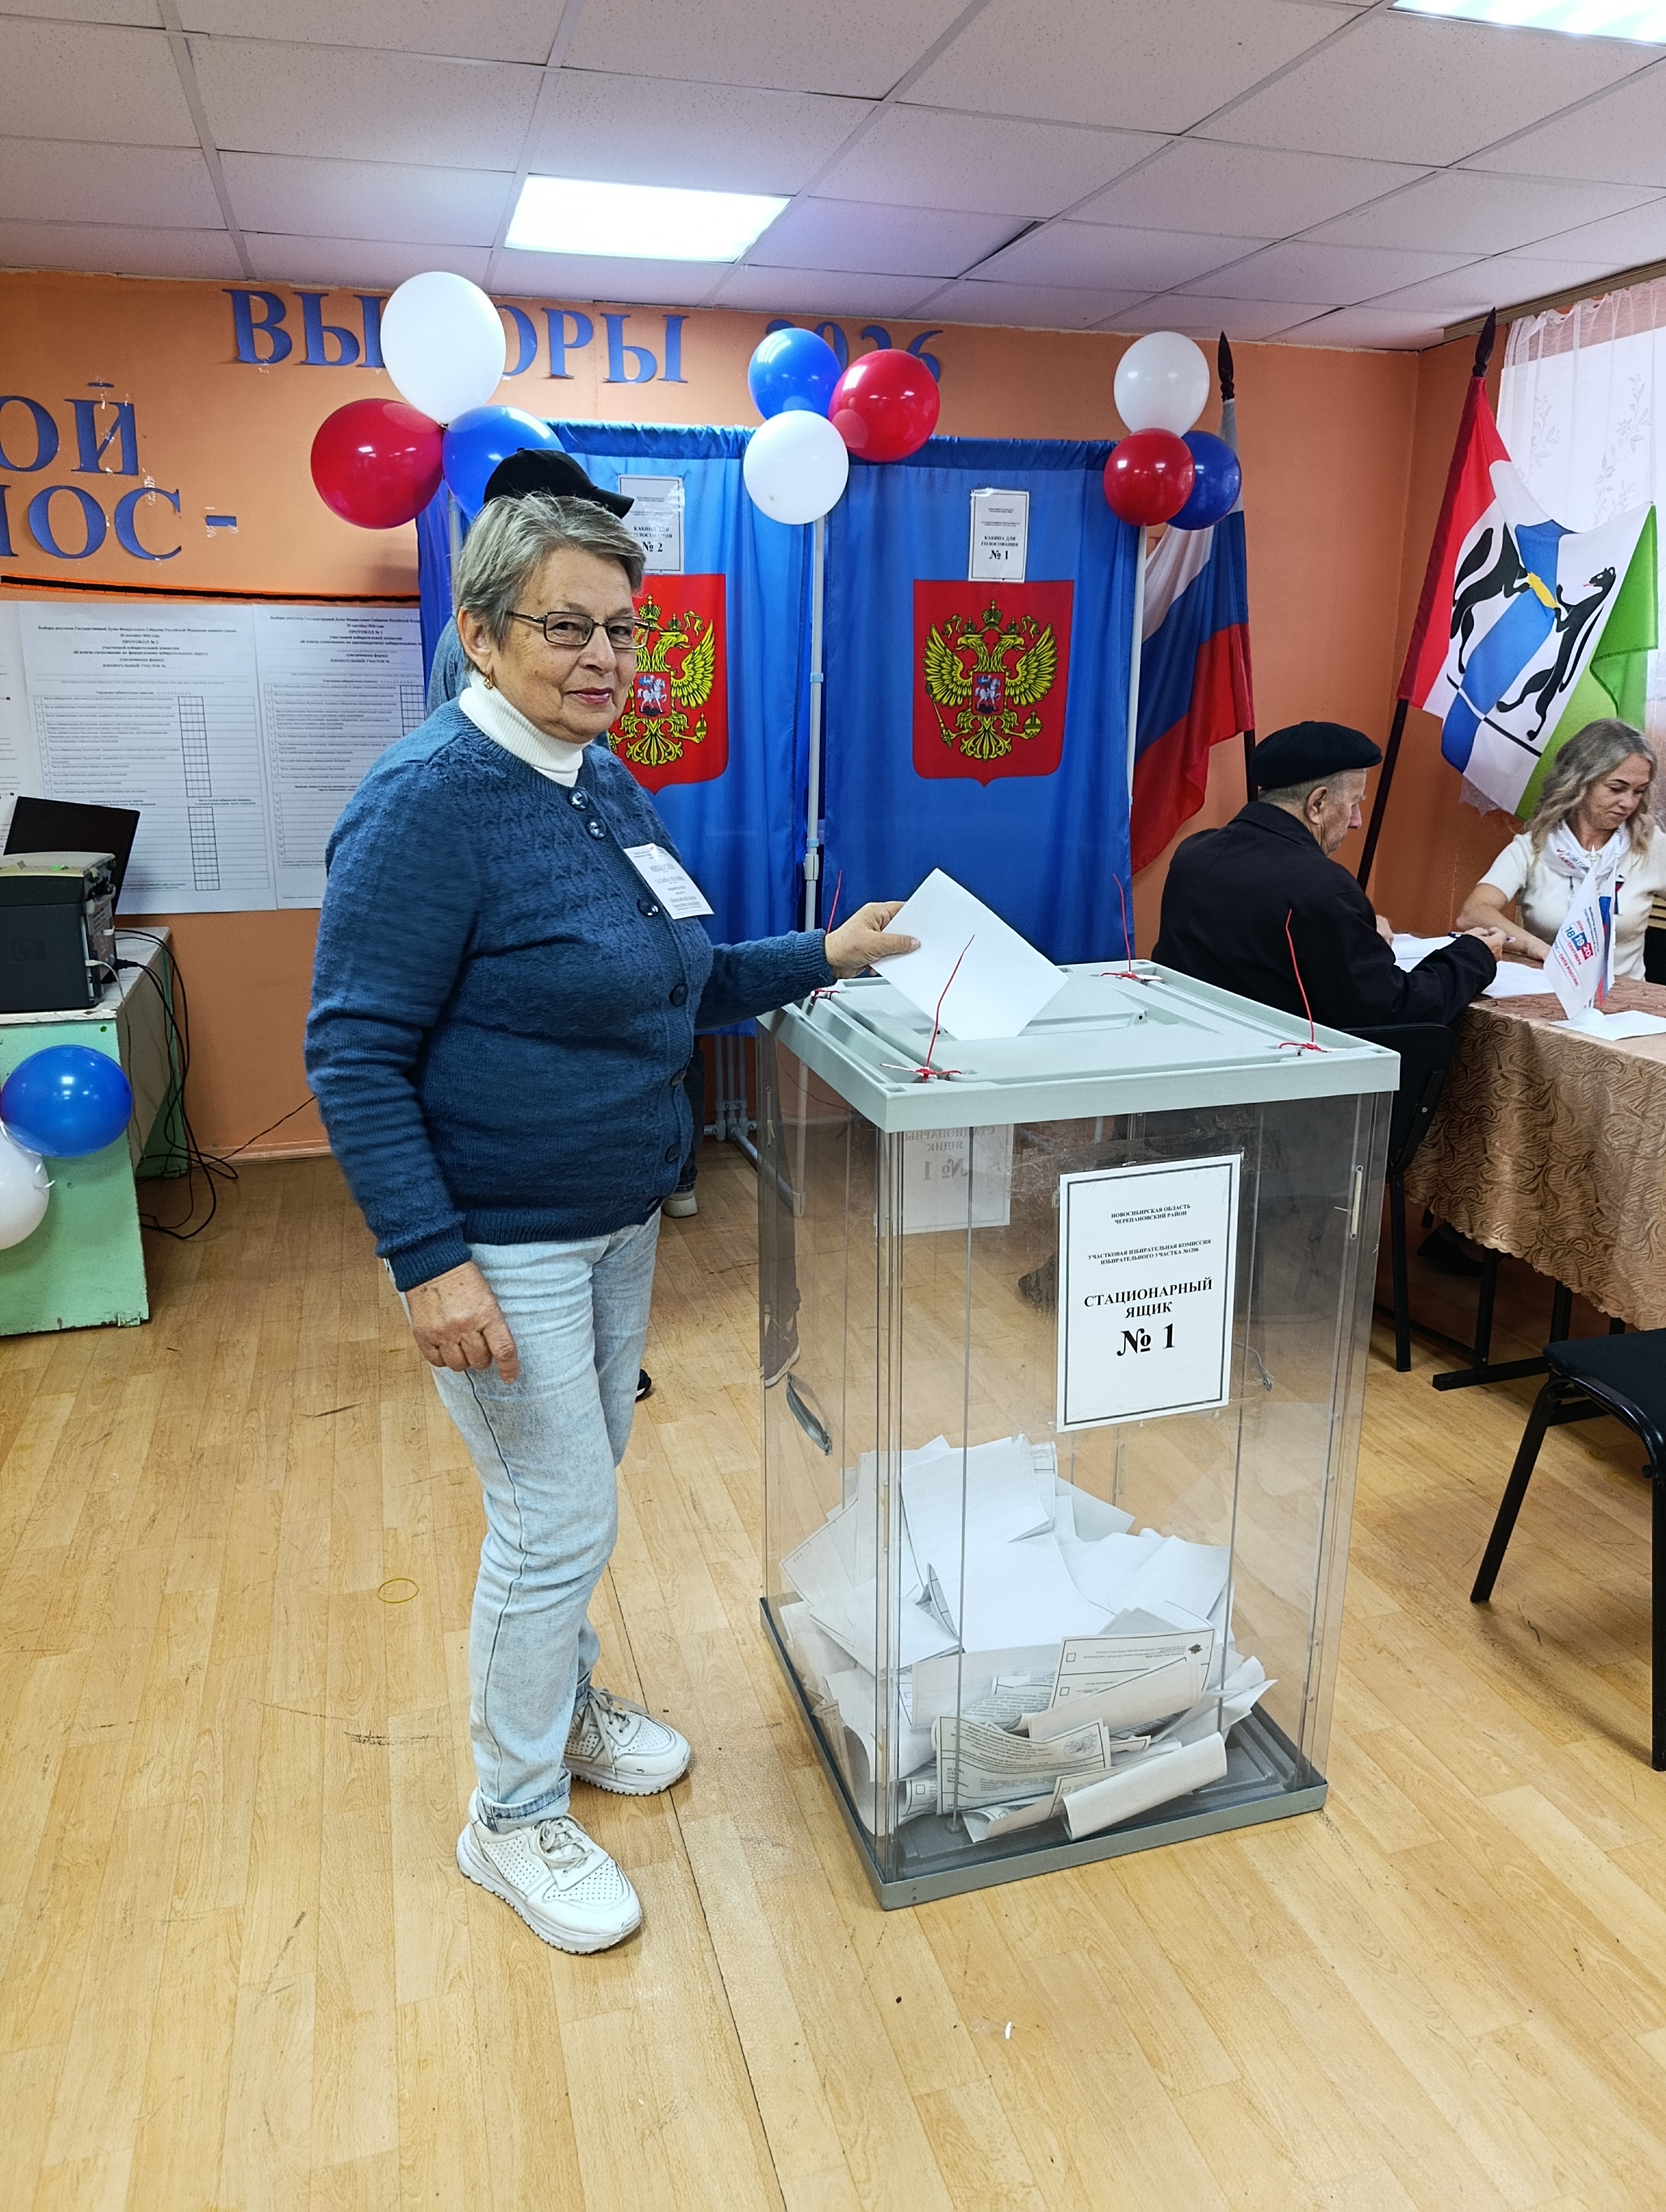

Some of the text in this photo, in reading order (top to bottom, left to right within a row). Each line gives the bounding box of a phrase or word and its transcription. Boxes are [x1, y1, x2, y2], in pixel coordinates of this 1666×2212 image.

[657, 543, 663, 552] 2
[989, 550, 1008, 560] № 1
[1565, 926, 1592, 957] 18 19 20
[1559, 954, 1568, 967] СИЛА
[1567, 942, 1582, 966] СЕНТЯБРЯ
[1111, 1204, 1191, 1219] НОВОСИБИРСКАЯ ОБЛАСТЬ
[1115, 1210, 1187, 1224] ЧЕРЕПАНОВСКИЙ РАЙОН
[1088, 1239, 1211, 1260] УЧАСТКОВАЯ ИЗБИРАТЕЛЬНАЯ КОМИССИЯ
[1100, 1253, 1154, 1265] ИЗБИРАТЕЛЬНОГО
[1155, 1249, 1182, 1258] УЧАСТКА
[1084, 1277, 1213, 1308] СТАЦИОНАРНЫЙ
[1125, 1301, 1172, 1319] ЯЩИК
[1117, 1323, 1176, 1356] № 1
